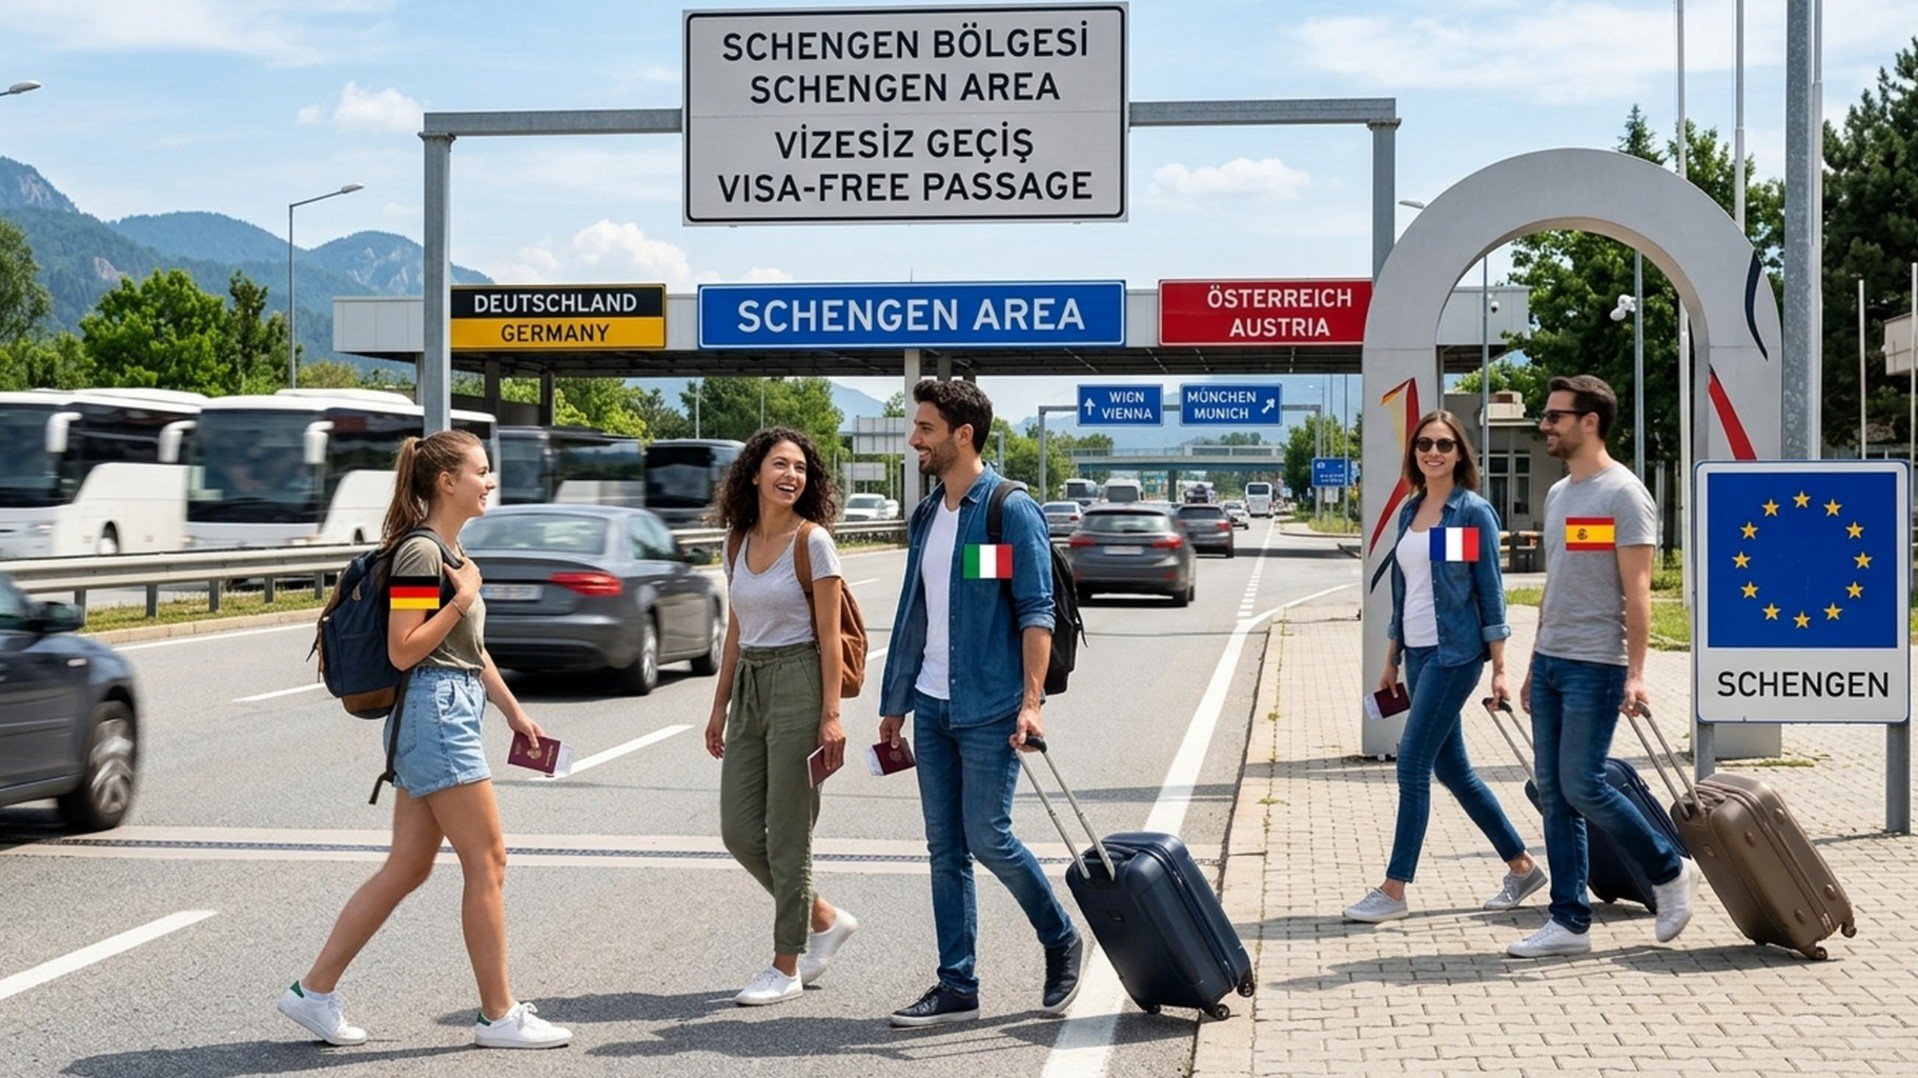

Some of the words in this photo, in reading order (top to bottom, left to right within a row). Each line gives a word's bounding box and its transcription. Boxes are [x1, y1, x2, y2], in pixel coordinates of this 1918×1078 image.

[722, 30, 919, 61] SCHENGEN
[933, 20, 1088, 59] BÖLGESİ
[750, 73, 947, 104] SCHENGEN
[961, 72, 1061, 102] AREA
[775, 122, 914, 159] VİZESİZ
[927, 121, 1034, 163] GEÇİŞ
[718, 173, 909, 203] VISA-FREE
[923, 170, 1093, 201] PASSAGE
[474, 292, 638, 313] DEUTSCHLAND
[1207, 284, 1352, 308] ÖSTERREICH
[737, 299, 958, 333] SCHENGEN
[972, 297, 1086, 331] AREA
[1229, 318, 1331, 337] AUSTRIA
[501, 323, 610, 343] GERMANY
[1101, 408, 1153, 420] VIENNA
[1194, 408, 1248, 420] MUNICH
[1717, 671, 1889, 698] SCHENGEN
